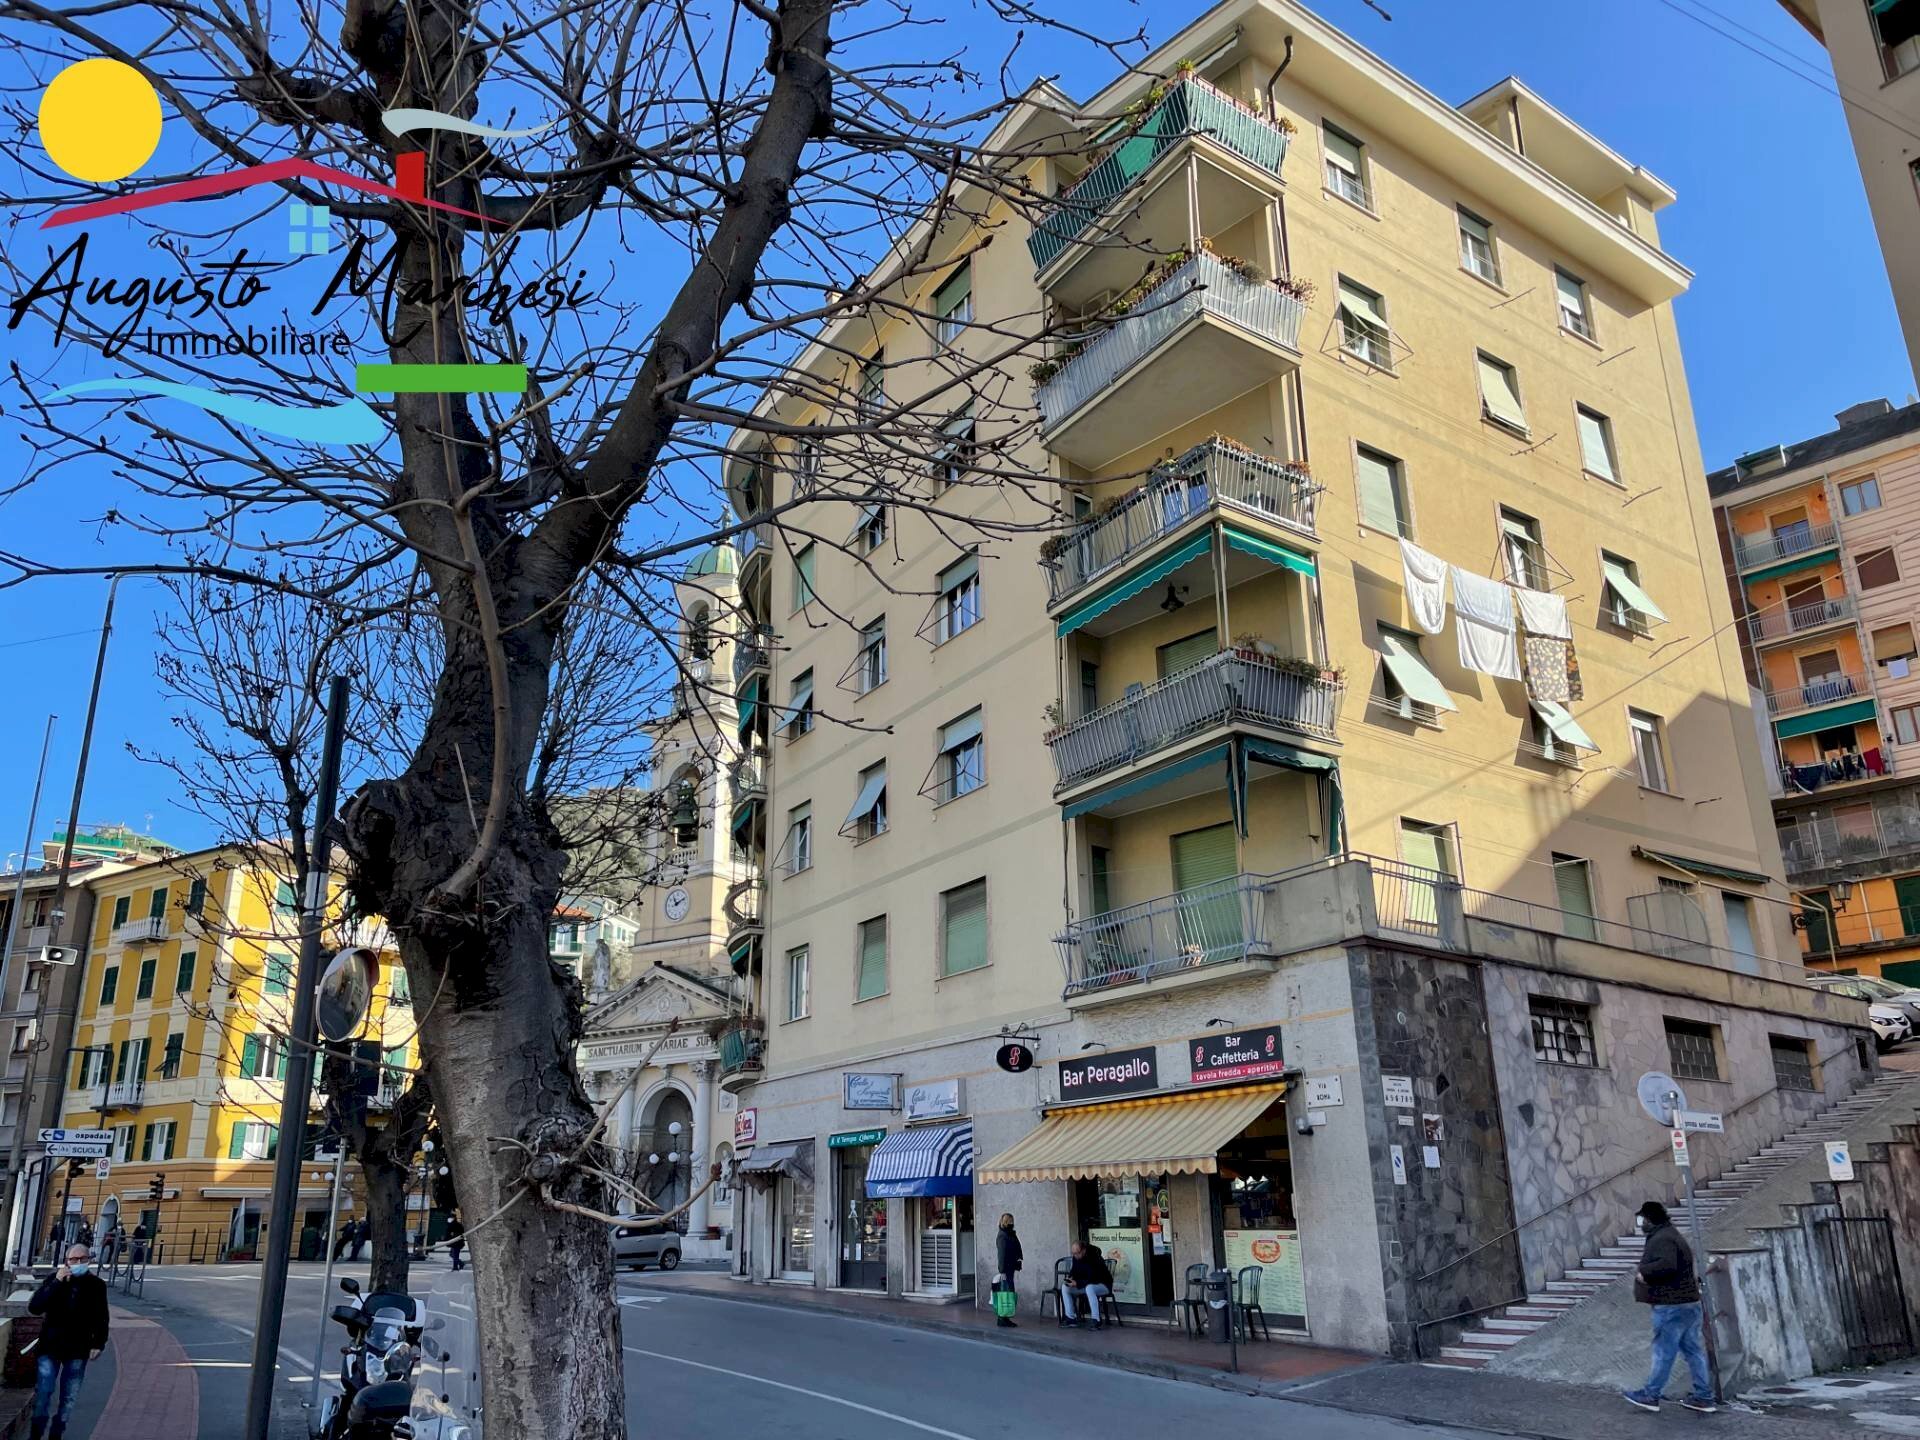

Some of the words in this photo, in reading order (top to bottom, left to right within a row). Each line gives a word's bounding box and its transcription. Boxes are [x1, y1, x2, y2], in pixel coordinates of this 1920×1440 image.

[1225, 1036, 1241, 1048] Bar
[588, 1043, 642, 1058] SANCTUARIUM
[1210, 1049, 1260, 1066] Caffetteria
[1063, 1069, 1084, 1087] Bar
[1087, 1058, 1150, 1083] Peragallo
[1196, 1071, 1217, 1081] tavola
[1218, 1067, 1241, 1078] fredda
[1247, 1063, 1279, 1075] aperitivi
[75, 1132, 111, 1140] ospedale
